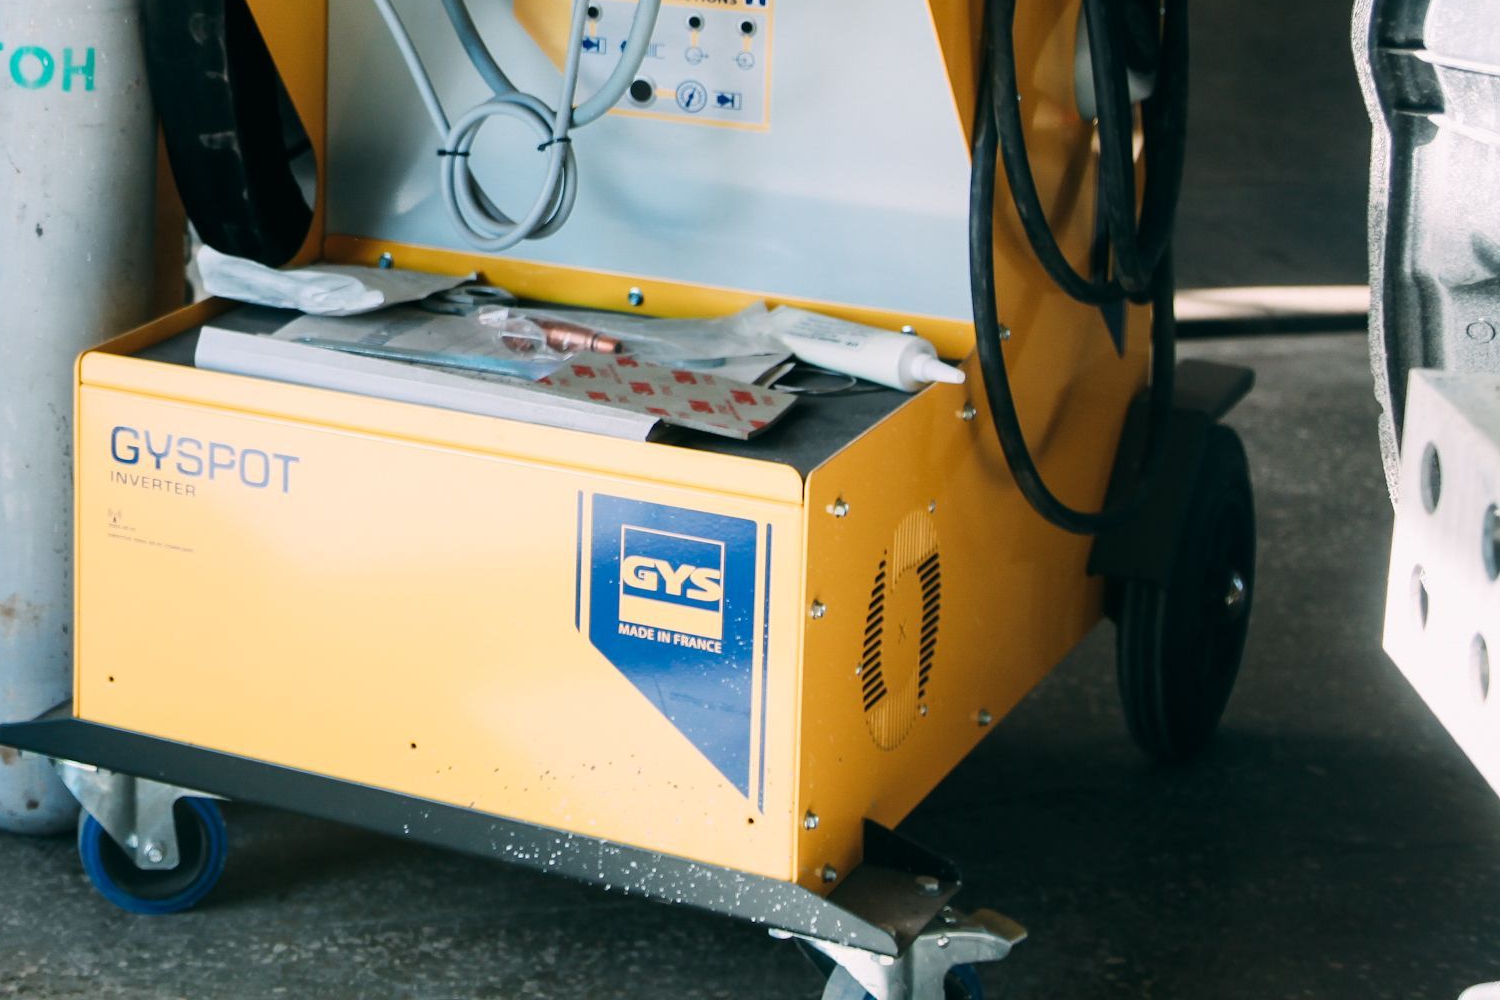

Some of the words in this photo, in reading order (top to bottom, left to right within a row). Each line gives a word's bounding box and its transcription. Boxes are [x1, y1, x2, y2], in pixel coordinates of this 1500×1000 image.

[110, 425, 300, 494] GYSPOT
[110, 470, 197, 497] INVERTER
[622, 555, 723, 602] GYS
[618, 623, 655, 641] MADE
[656, 631, 671, 643] IN
[673, 635, 723, 654] FRANCE
